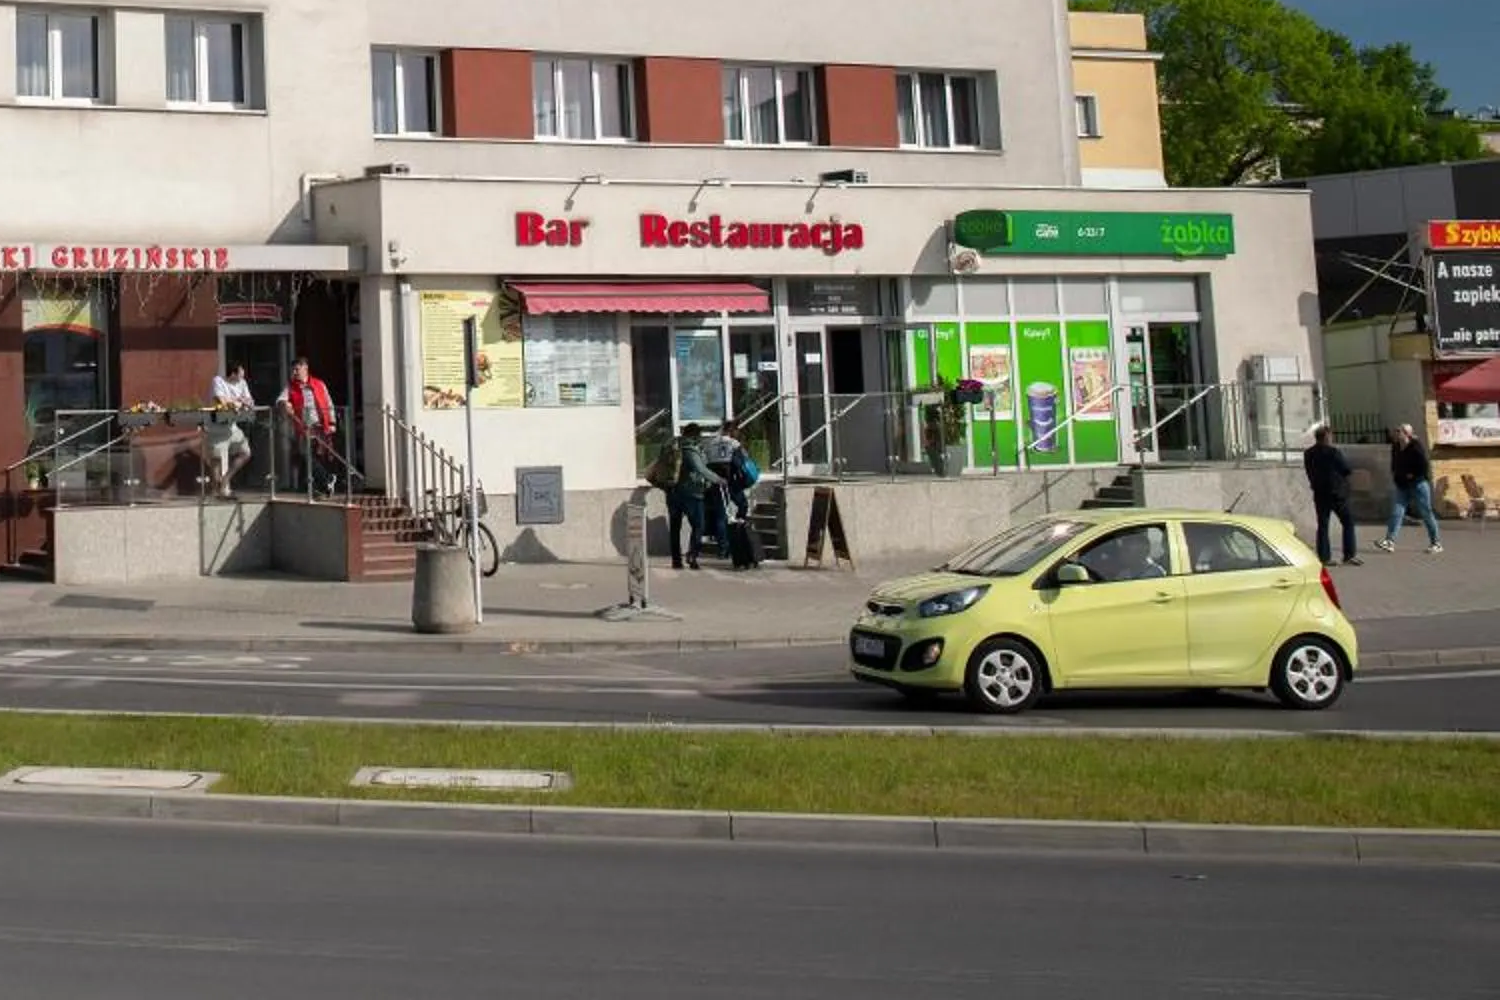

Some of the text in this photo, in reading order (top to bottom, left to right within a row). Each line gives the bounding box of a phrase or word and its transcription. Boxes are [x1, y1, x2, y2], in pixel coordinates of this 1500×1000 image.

[514, 211, 865, 256] Bar Restauracja
[1159, 217, 1231, 245] żabka
[51, 243, 229, 270] GRUZIŃSKIE
[1437, 261, 1493, 278] A nasze
